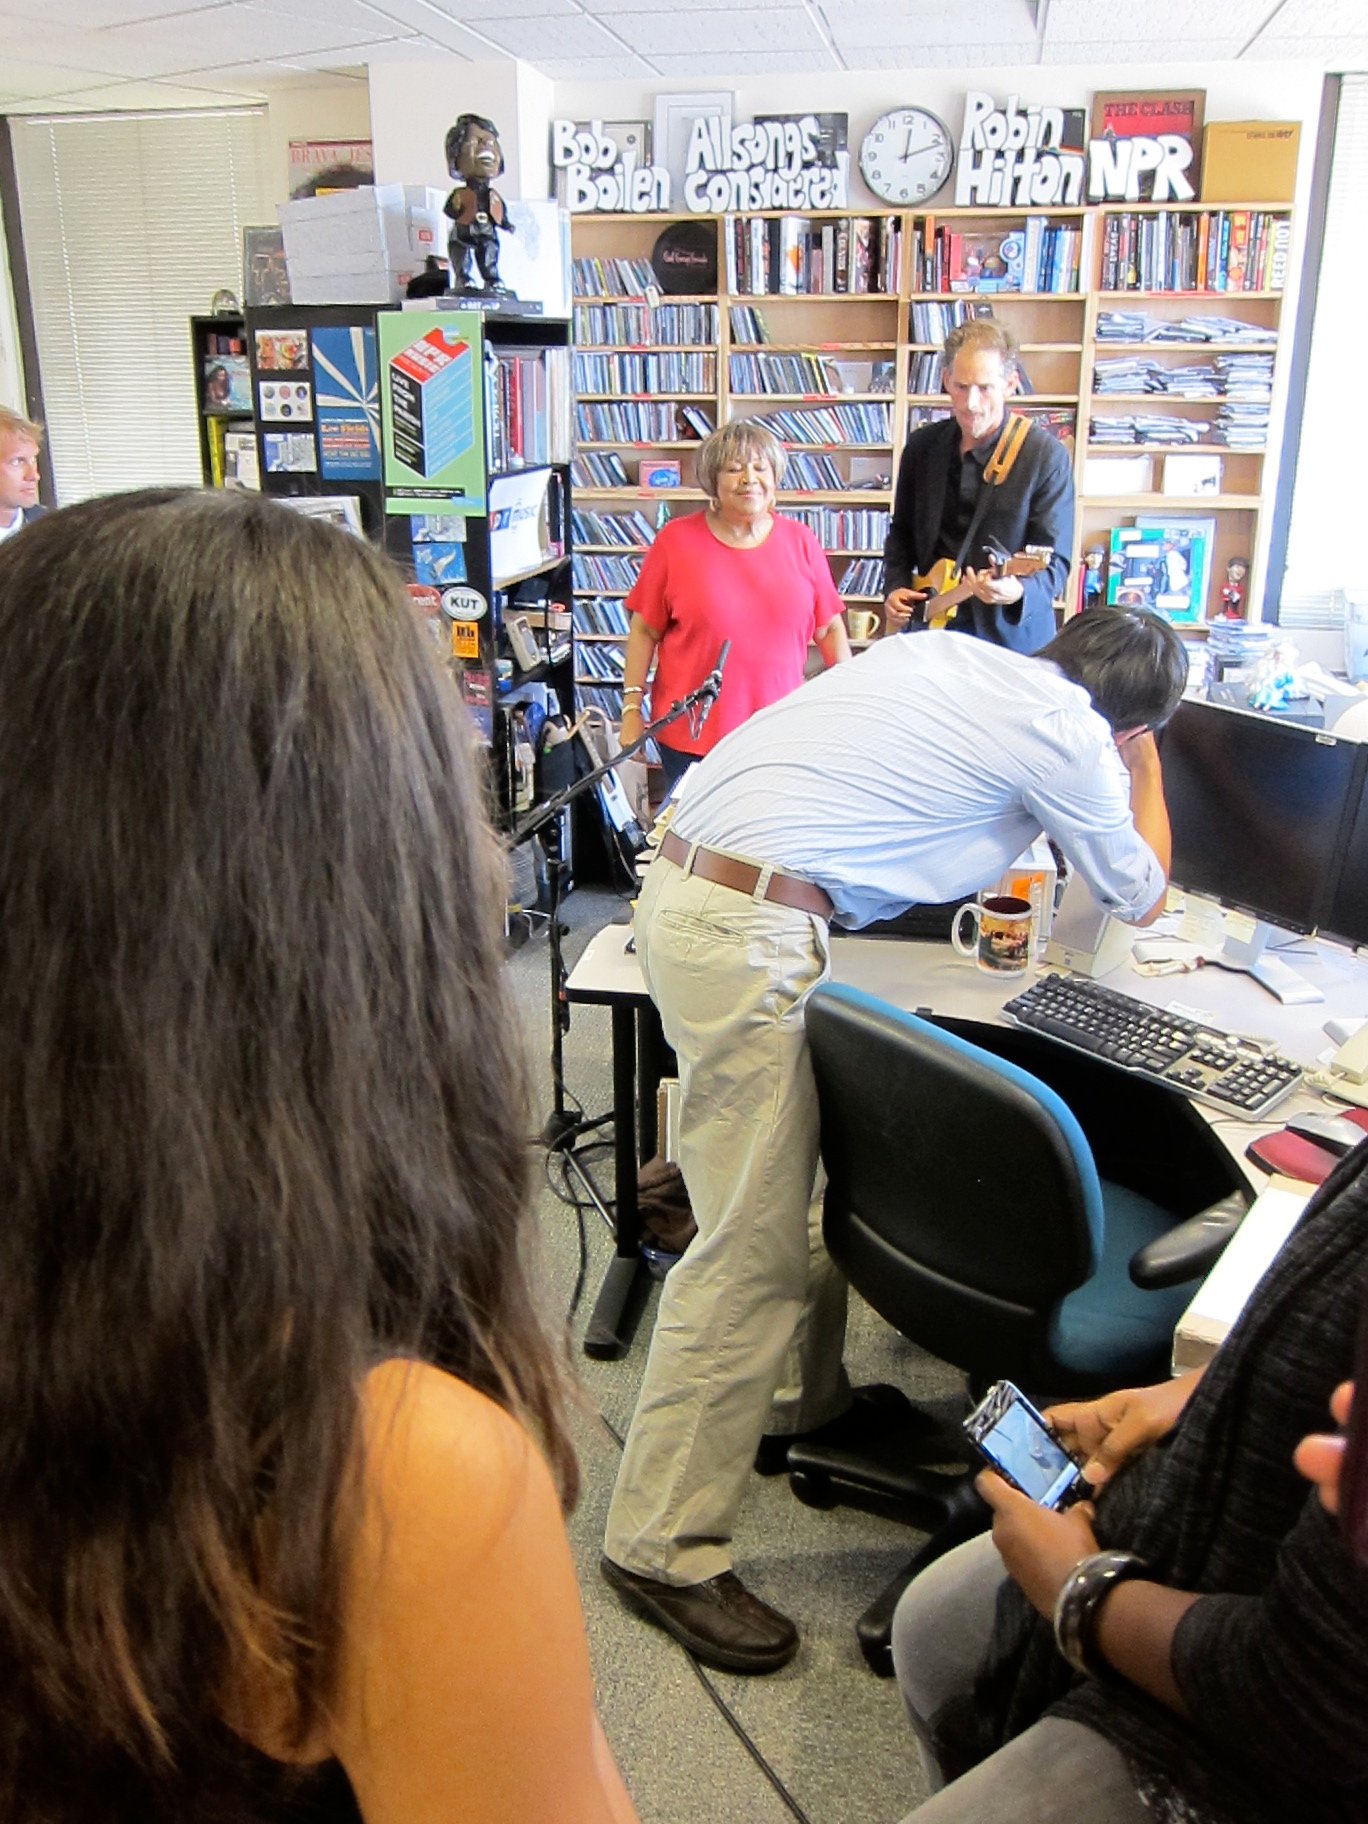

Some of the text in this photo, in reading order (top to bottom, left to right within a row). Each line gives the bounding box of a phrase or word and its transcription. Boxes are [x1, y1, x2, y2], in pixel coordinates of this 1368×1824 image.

[903, 115, 914, 125] 12
[961, 91, 1064, 150] Robin
[875, 133, 884, 143] 10
[553, 119, 617, 169] Bob
[868, 152, 877, 161] 9
[1088, 134, 1196, 201] NPR
[872, 170, 881, 180] 8
[930, 170, 939, 179] 4
[955, 147, 1085, 207] Hilton
[566, 151, 671, 213] Boilen
[883, 183, 892, 193] 7
[899, 189, 908, 199] 6
[450, 596, 479, 610] KUT
